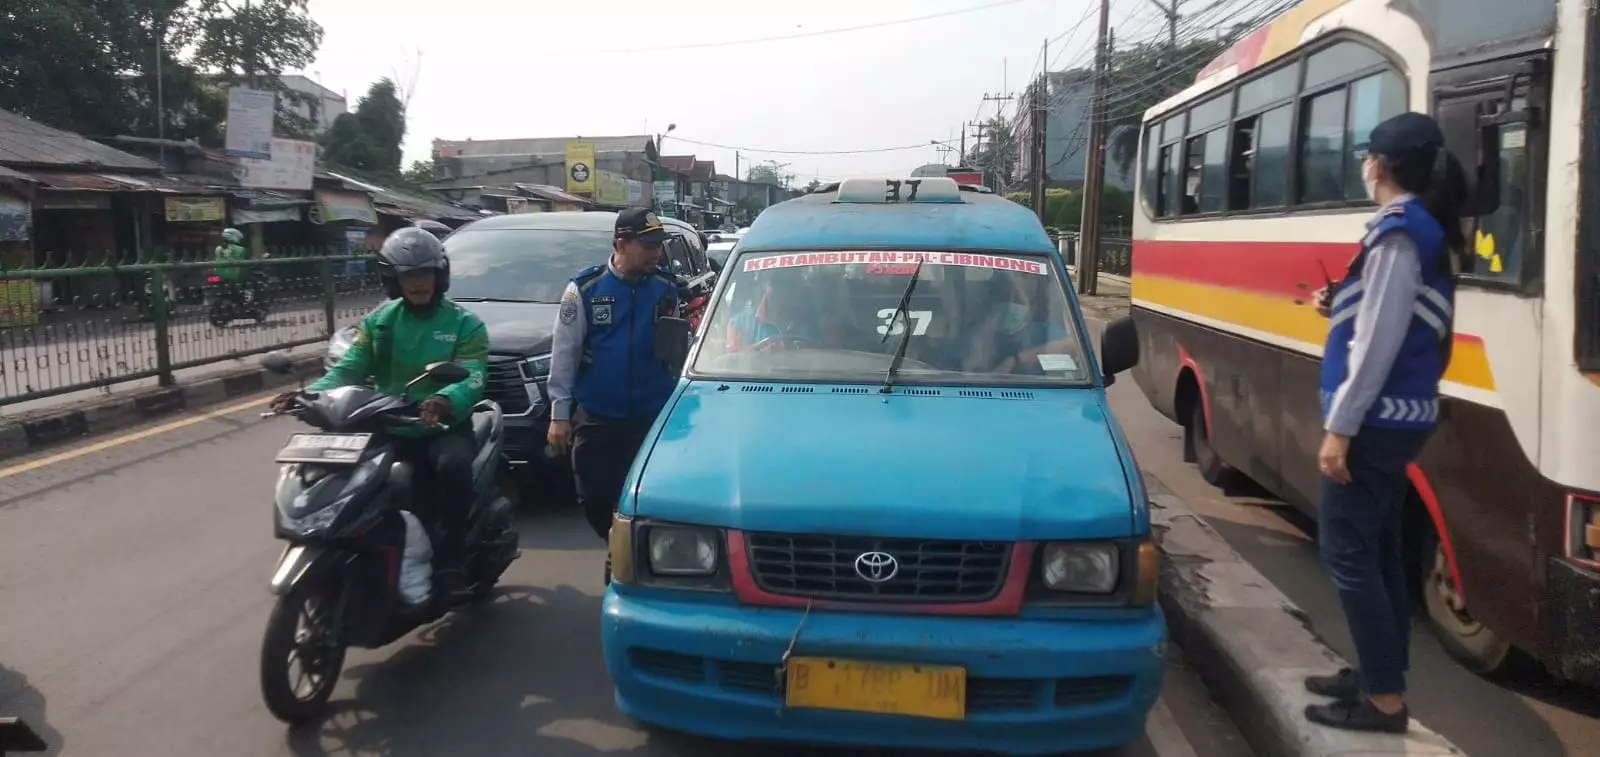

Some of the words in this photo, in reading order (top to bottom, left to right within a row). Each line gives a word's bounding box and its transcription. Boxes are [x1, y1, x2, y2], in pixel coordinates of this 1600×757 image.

[885, 179, 921, 202] 37
[877, 308, 932, 335] 37
[796, 664, 810, 690] B
